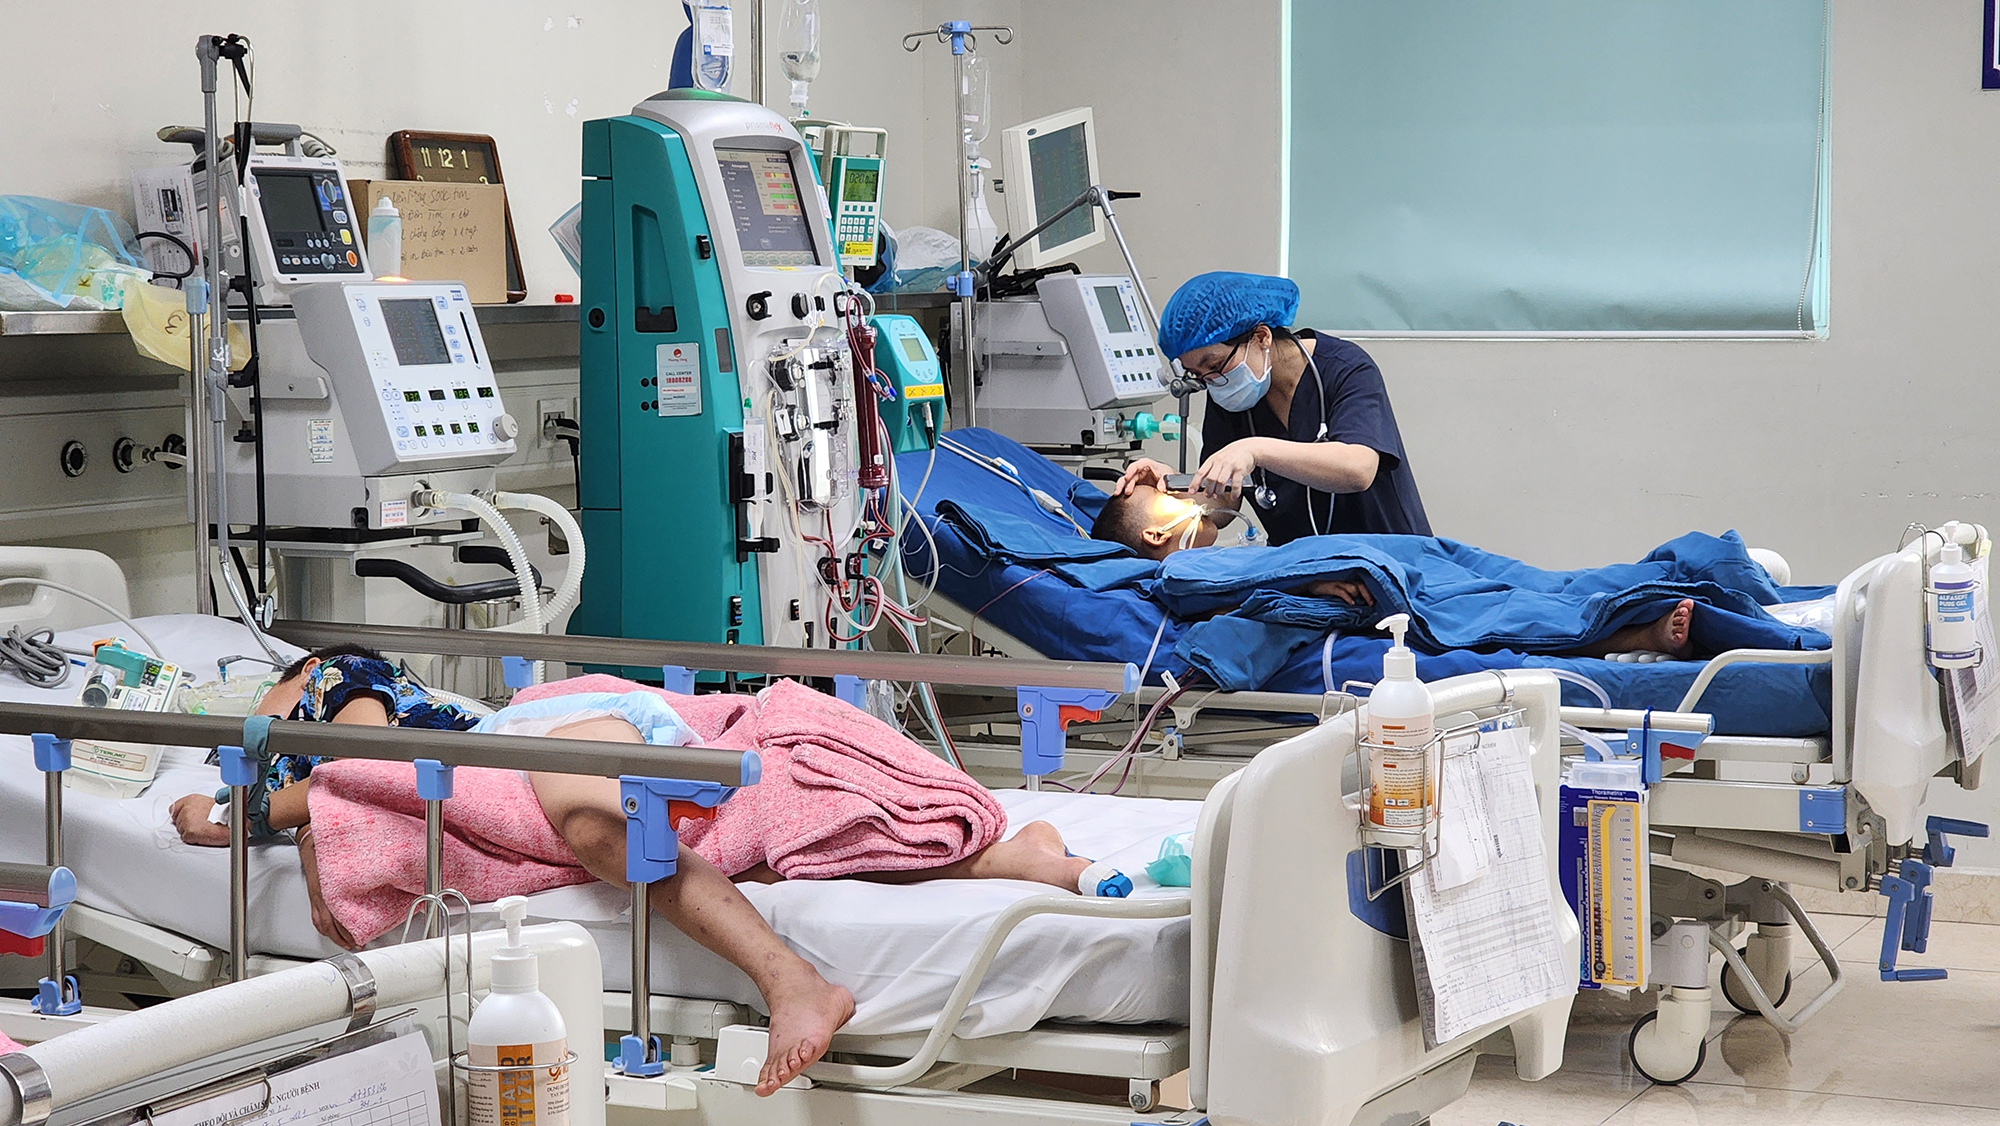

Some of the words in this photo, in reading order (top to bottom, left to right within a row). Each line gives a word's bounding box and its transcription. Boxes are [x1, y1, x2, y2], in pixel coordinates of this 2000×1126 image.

[420, 146, 432, 168] 11
[438, 146, 454, 168] 12
[461, 148, 469, 169] 1
